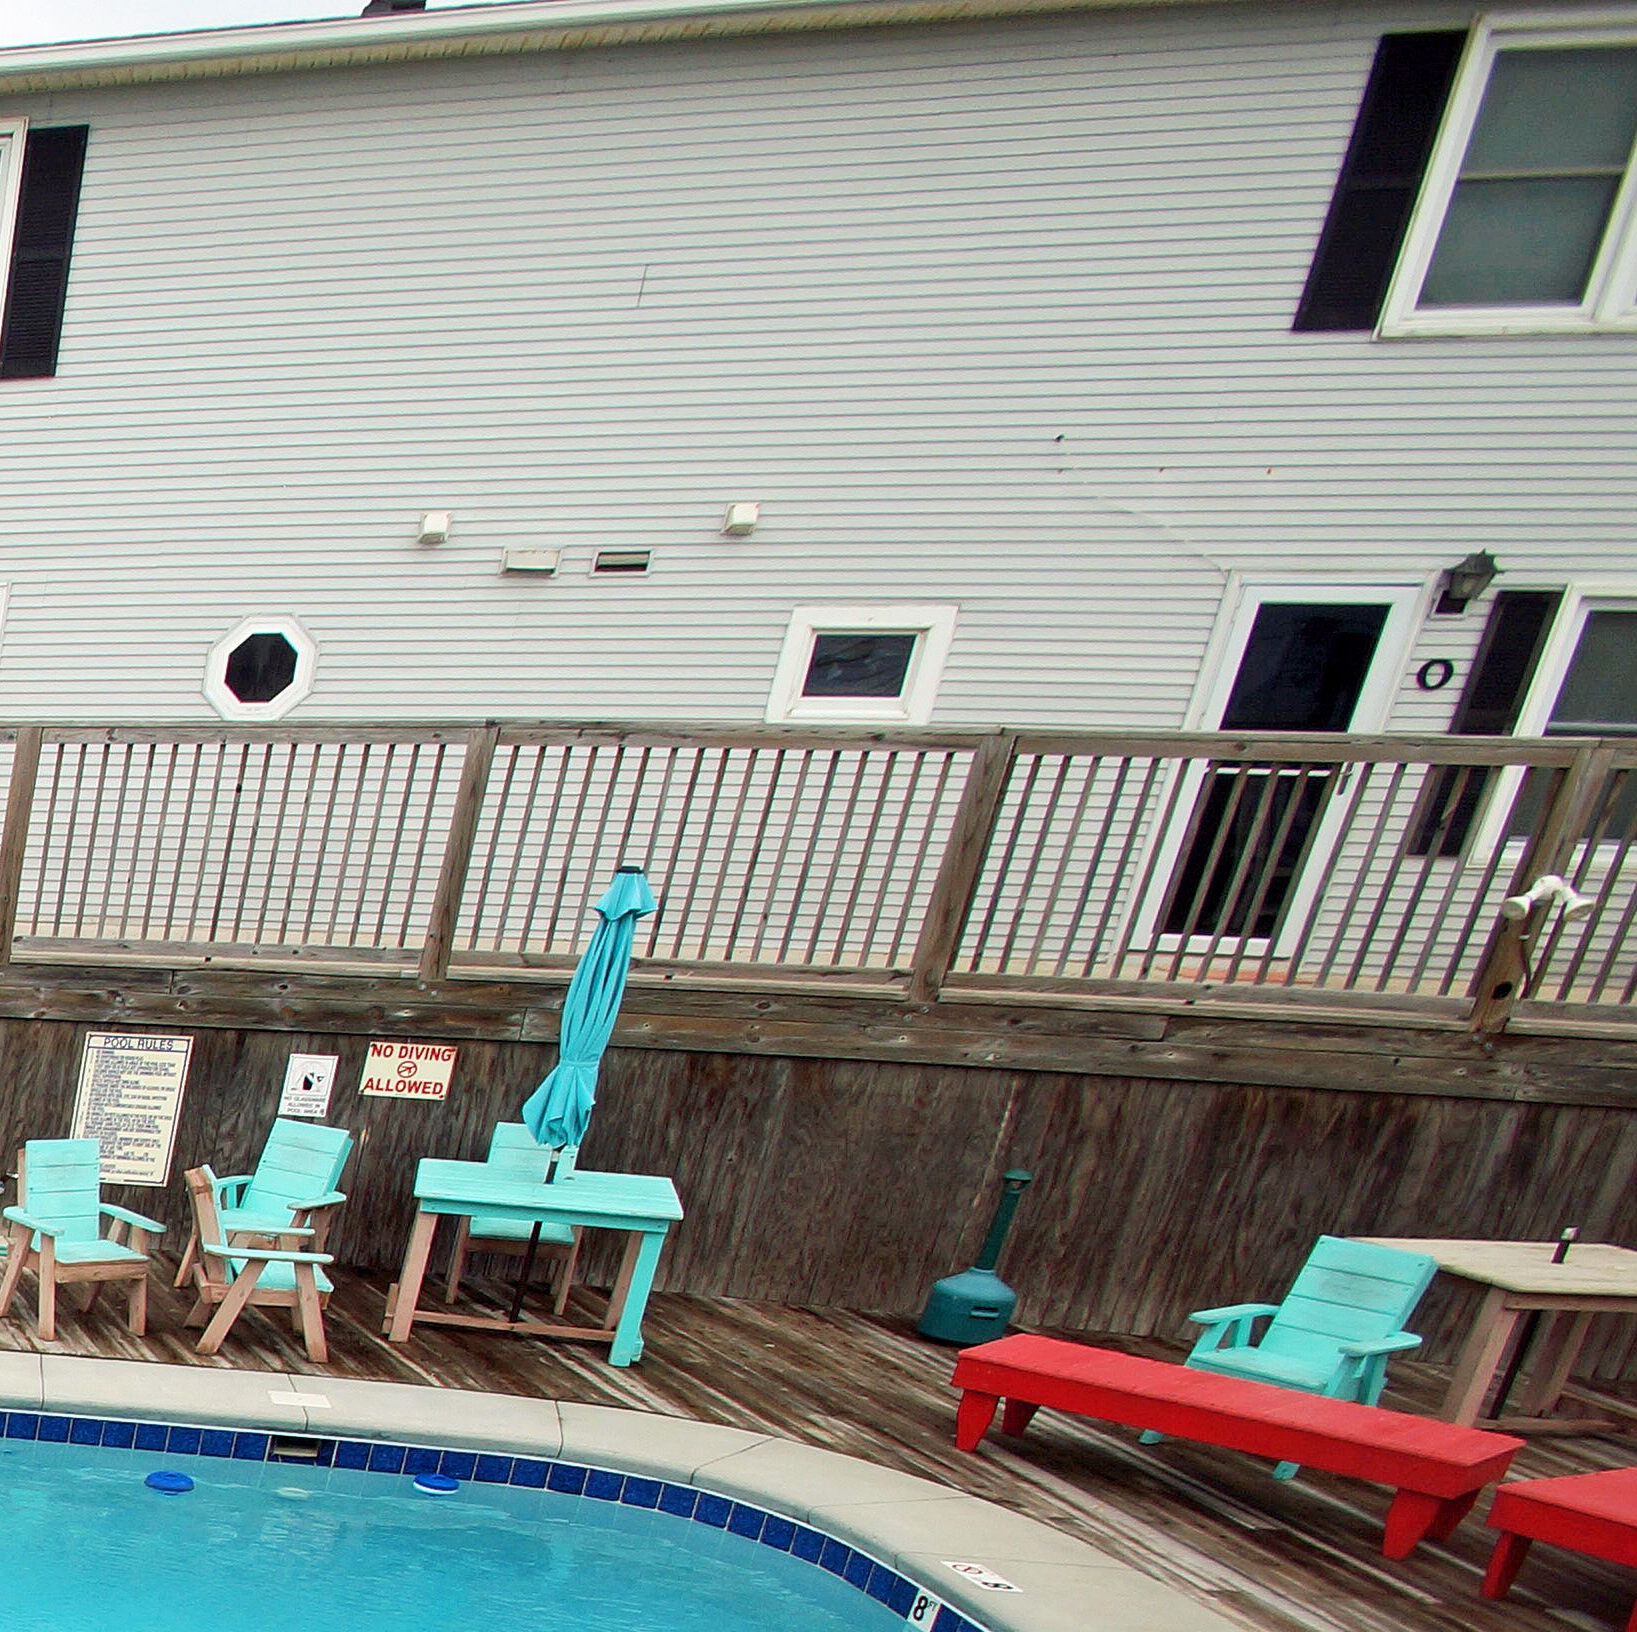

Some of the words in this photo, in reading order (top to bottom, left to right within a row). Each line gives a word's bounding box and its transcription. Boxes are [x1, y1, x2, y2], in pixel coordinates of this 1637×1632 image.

[1416, 658, 1454, 691] O
[104, 1037, 134, 1049] POOL
[137, 1039, 174, 1051] RULES
[371, 1044, 394, 1058] NO
[398, 1045, 455, 1062] DIVING
[364, 1077, 443, 1095] ALLOWED
[913, 1595, 928, 1621] 8
